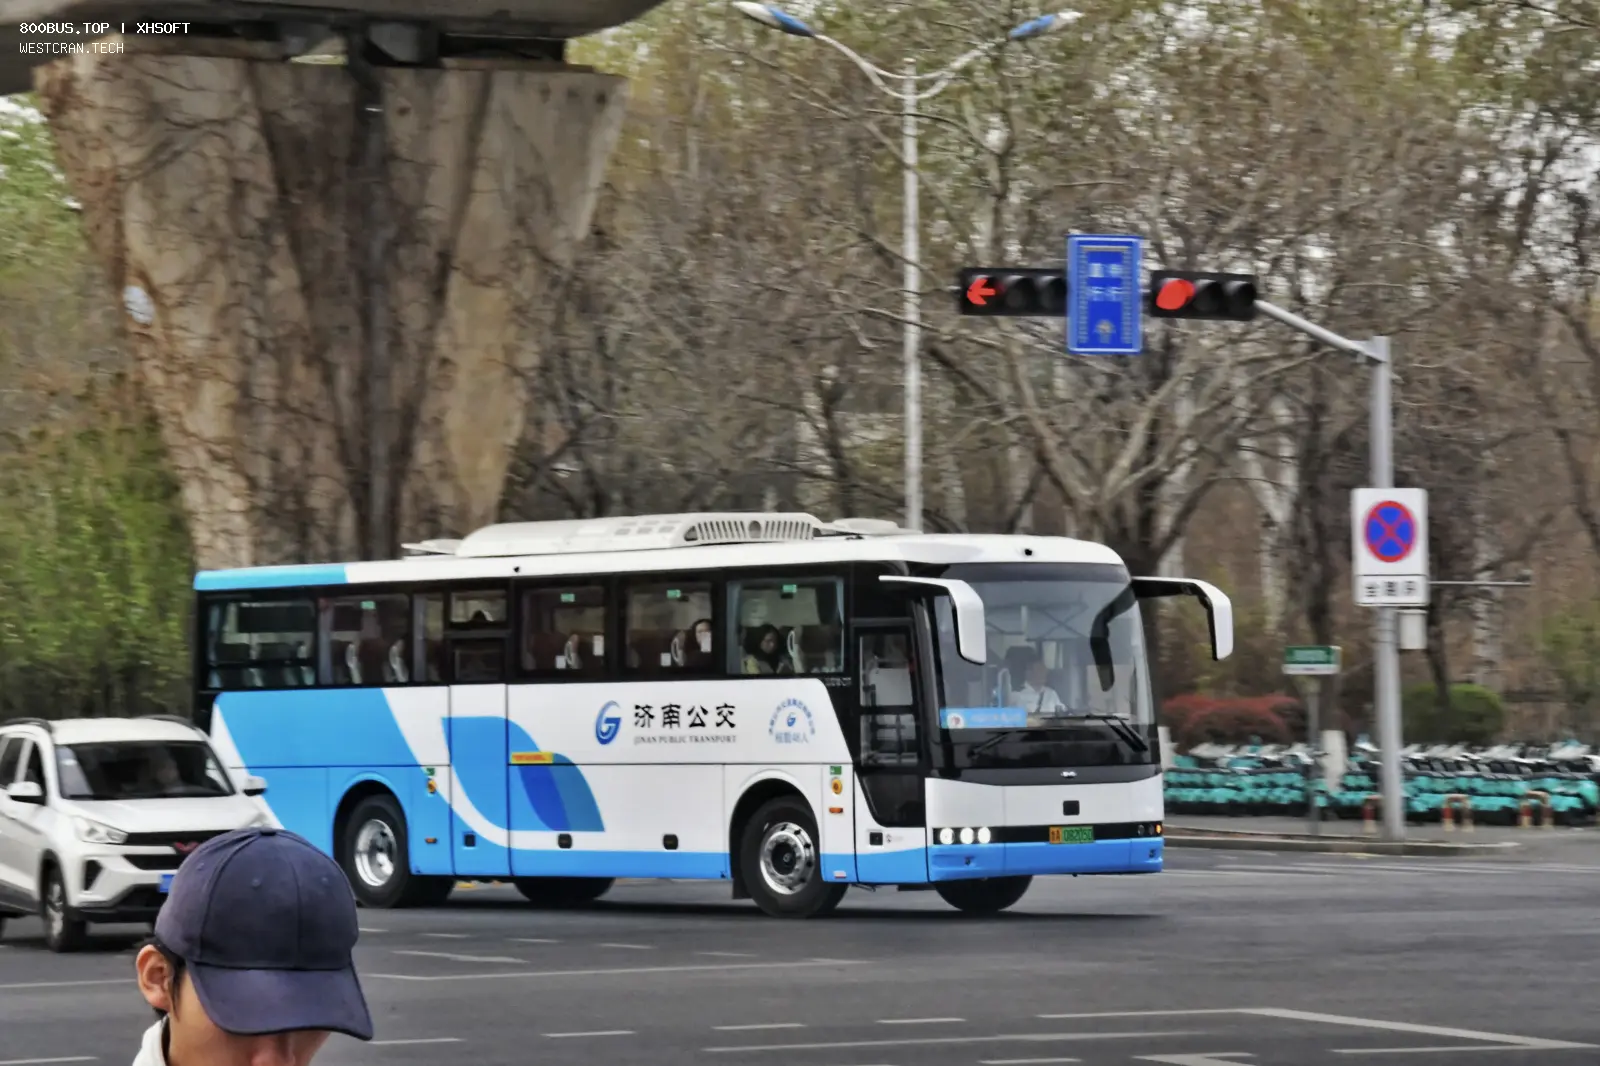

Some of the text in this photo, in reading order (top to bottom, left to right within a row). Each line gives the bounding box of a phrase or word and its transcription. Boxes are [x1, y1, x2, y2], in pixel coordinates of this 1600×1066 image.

[634, 702, 737, 729] 济南公交
[634, 735, 737, 745] JINAN PUBLIC TRANSPORT
